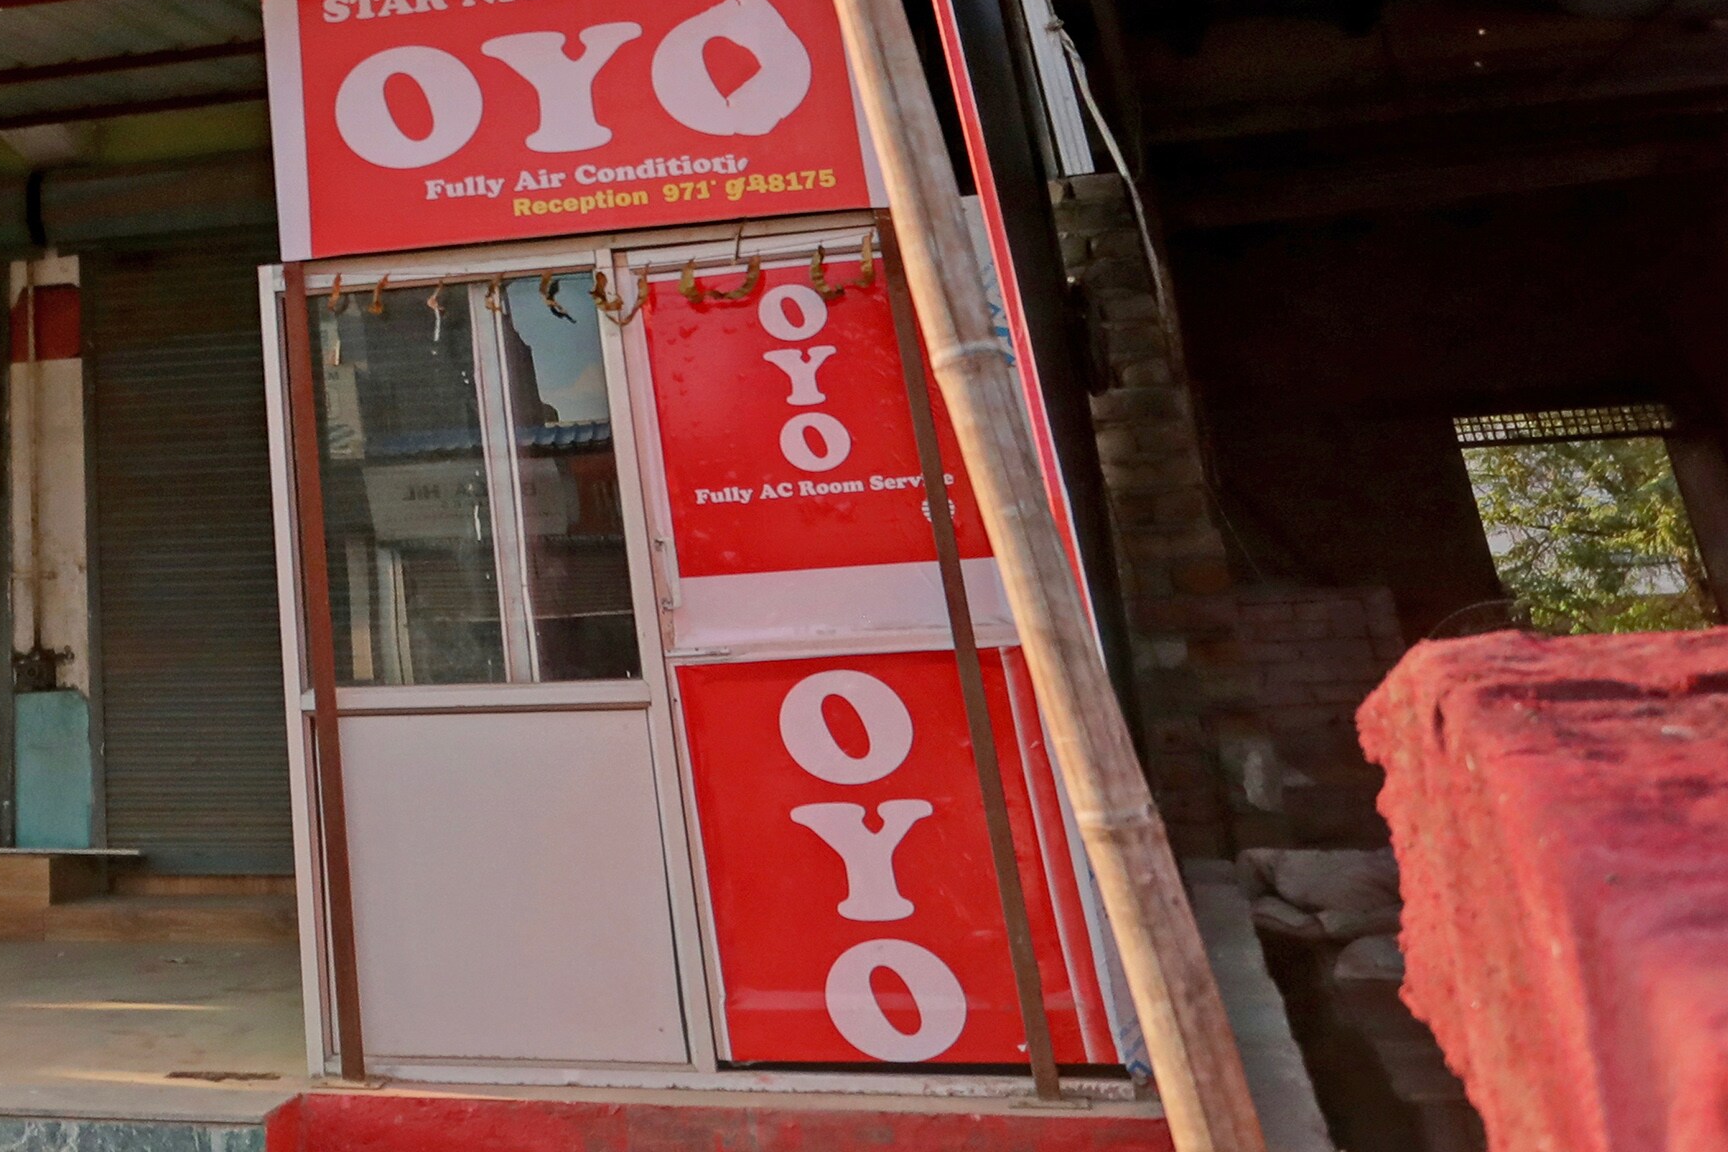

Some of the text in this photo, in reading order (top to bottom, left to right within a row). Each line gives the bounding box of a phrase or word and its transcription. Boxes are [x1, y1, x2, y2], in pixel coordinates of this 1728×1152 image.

[425, 172, 505, 202] Fully
[512, 167, 566, 192] Air
[513, 188, 648, 217] Reception
[757, 284, 852, 472] OYO
[695, 472, 955, 505] Fully AC Room Serve
[779, 670, 966, 1063] OYO
